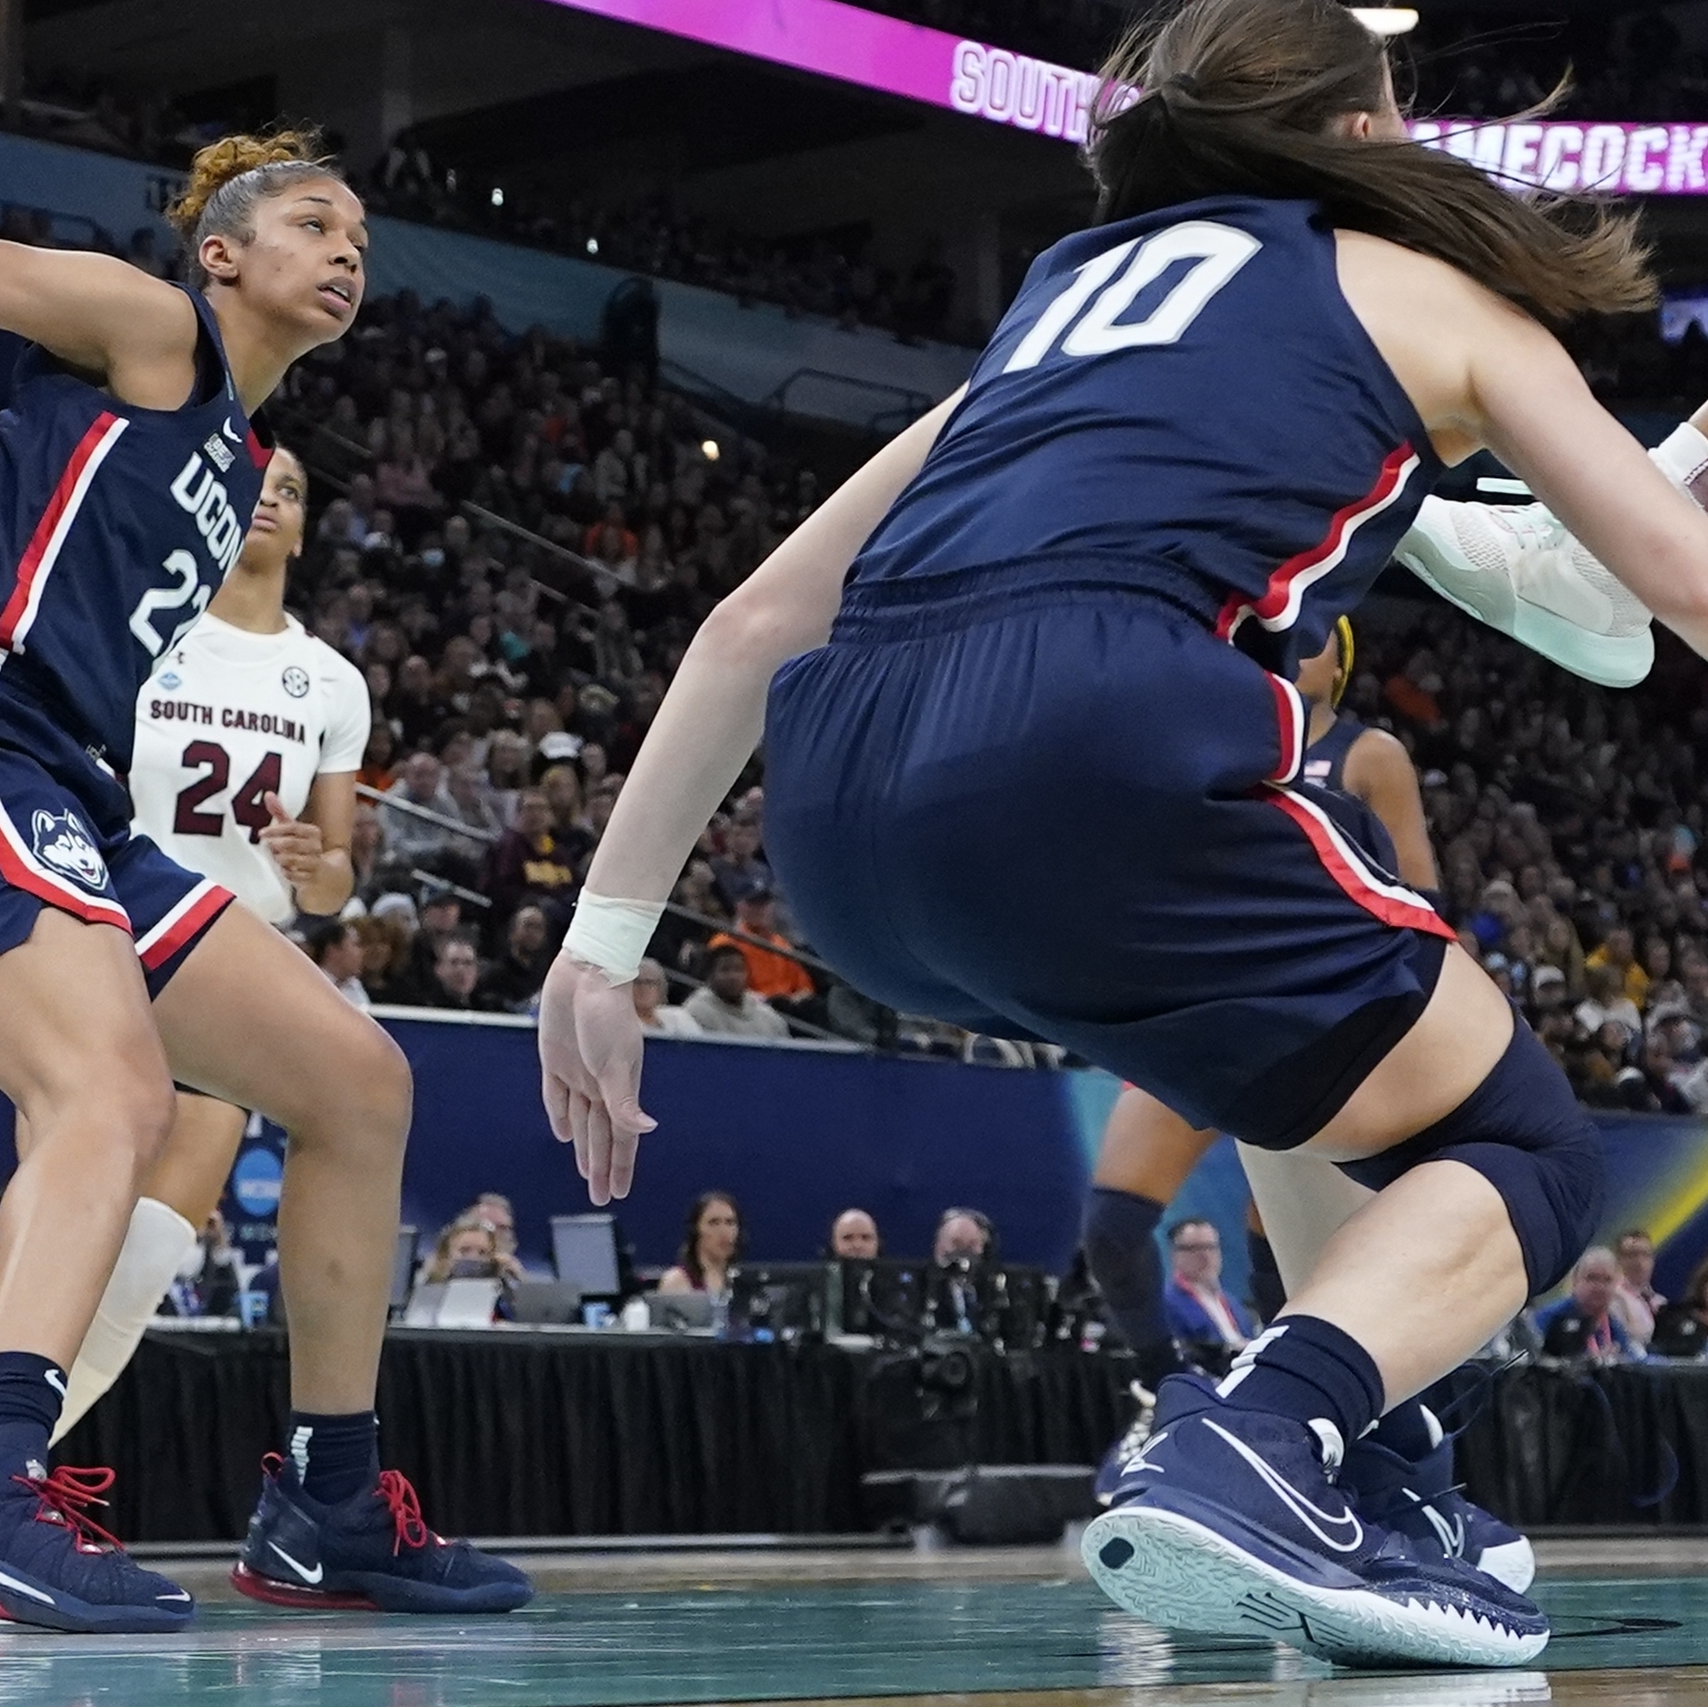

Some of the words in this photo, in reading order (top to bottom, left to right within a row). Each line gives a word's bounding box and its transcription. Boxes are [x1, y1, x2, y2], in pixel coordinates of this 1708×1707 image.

[950, 40, 1101, 143] SOUTH
[1002, 220, 1264, 374] 10
[170, 451, 244, 583] UCON
[150, 700, 213, 725] SOUTH
[222, 709, 306, 745] CAROLINA
[173, 740, 283, 844] 24
